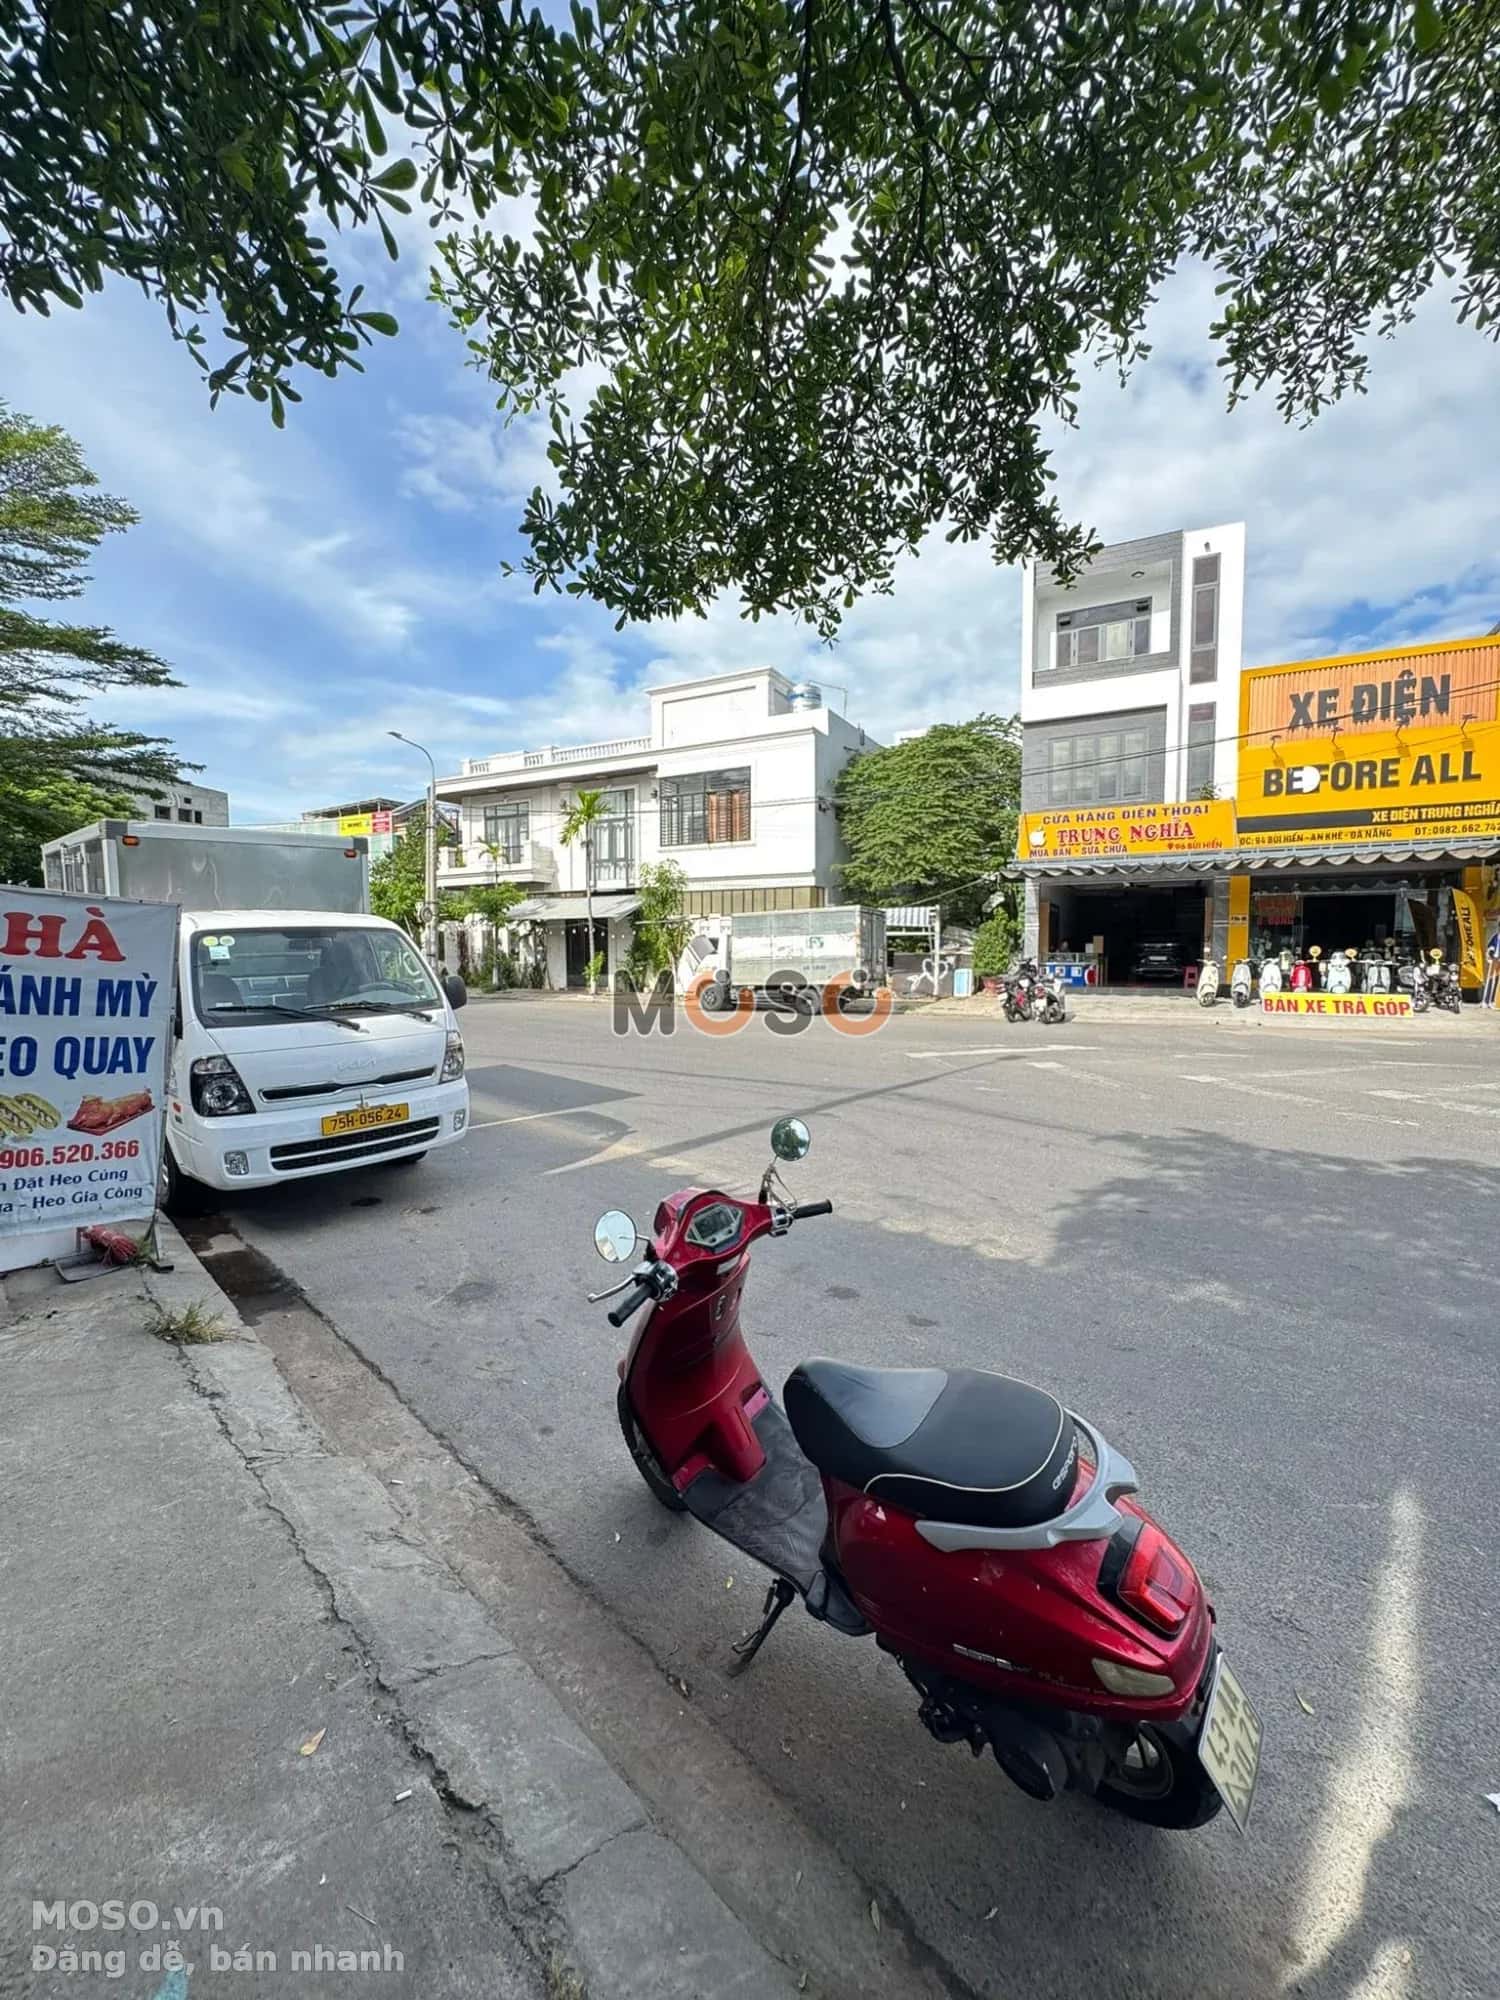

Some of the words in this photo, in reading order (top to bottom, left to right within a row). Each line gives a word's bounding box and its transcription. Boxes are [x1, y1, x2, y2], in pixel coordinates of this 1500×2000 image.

[1289, 688, 1340, 731] XE
[1351, 669, 1451, 726] ĐIỆN
[1263, 757, 1400, 798] BEFORE
[1411, 750, 1482, 787] ALL
[1076, 809, 1115, 823] HÀNG
[1162, 804, 1209, 816] THOẠI
[1372, 810, 1388, 823] XE
[1390, 807, 1418, 822] ĐIỆN
[1420, 805, 1462, 820] TRUNG
[1057, 827, 1121, 845] TRUNG
[1130, 816, 1195, 842] NGHĨA
[1029, 848, 1049, 858] MUA
[0, 906, 126, 962] HÀ
[96, 972, 158, 1017] MỲ
[1305, 1000, 1327, 1013] XE
[1333, 995, 1367, 1014] TRẢ
[1373, 997, 1411, 1016] GÓP
[54, 1036, 156, 1079] QUAY
[14, 1176, 43, 1192] Đặt
[50, 1173, 82, 1187] Heo
[32, 1196, 66, 1210] Heo
[72, 1190, 98, 1204] Gia
[104, 1186, 143, 1199] Công
